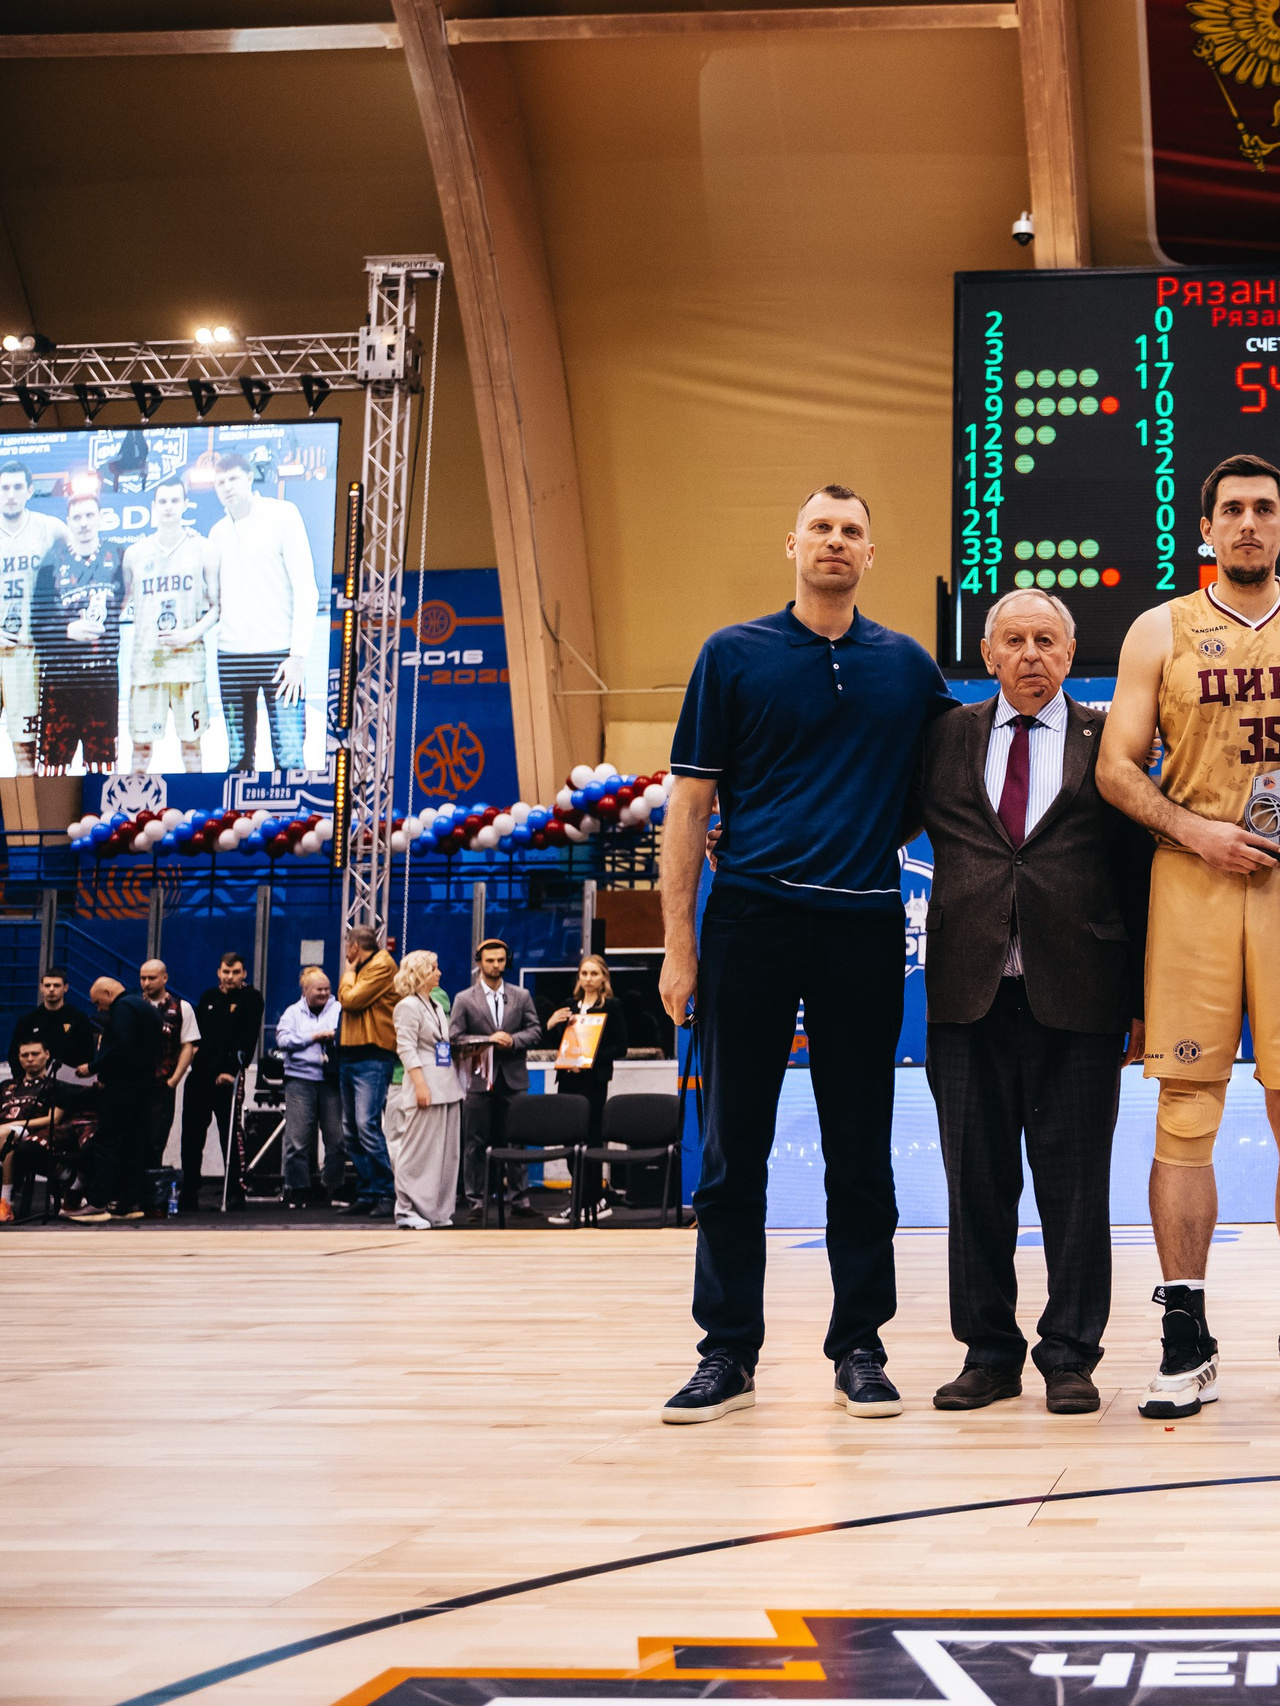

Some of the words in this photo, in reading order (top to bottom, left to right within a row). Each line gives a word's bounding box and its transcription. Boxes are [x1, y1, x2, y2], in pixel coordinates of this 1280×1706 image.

[985, 311, 1003, 337] 2
[1155, 306, 1173, 332] 0
[985, 339, 1003, 365] 3
[1135, 334, 1168, 361] 11
[985, 367, 1003, 393] 5
[1135, 360, 1174, 389] 17
[985, 395, 1003, 421] 9
[1155, 390, 1173, 417] 0
[965, 423, 1002, 450] 12
[1136, 416, 1174, 446] 13
[965, 451, 1002, 478] 13
[1155, 447, 1174, 474] 2
[965, 480, 1004, 507] 14
[1156, 475, 1174, 502] 0
[962, 508, 997, 536] 21
[1156, 504, 1175, 531] 0
[0, 555, 41, 573] ИВС
[962, 537, 1002, 565] 33
[1157, 533, 1175, 560] 9
[142, 575, 193, 594] ЦИВС
[961, 566, 998, 594] 41
[1156, 559, 1175, 589] 2
[401, 649, 484, 666] 2016
